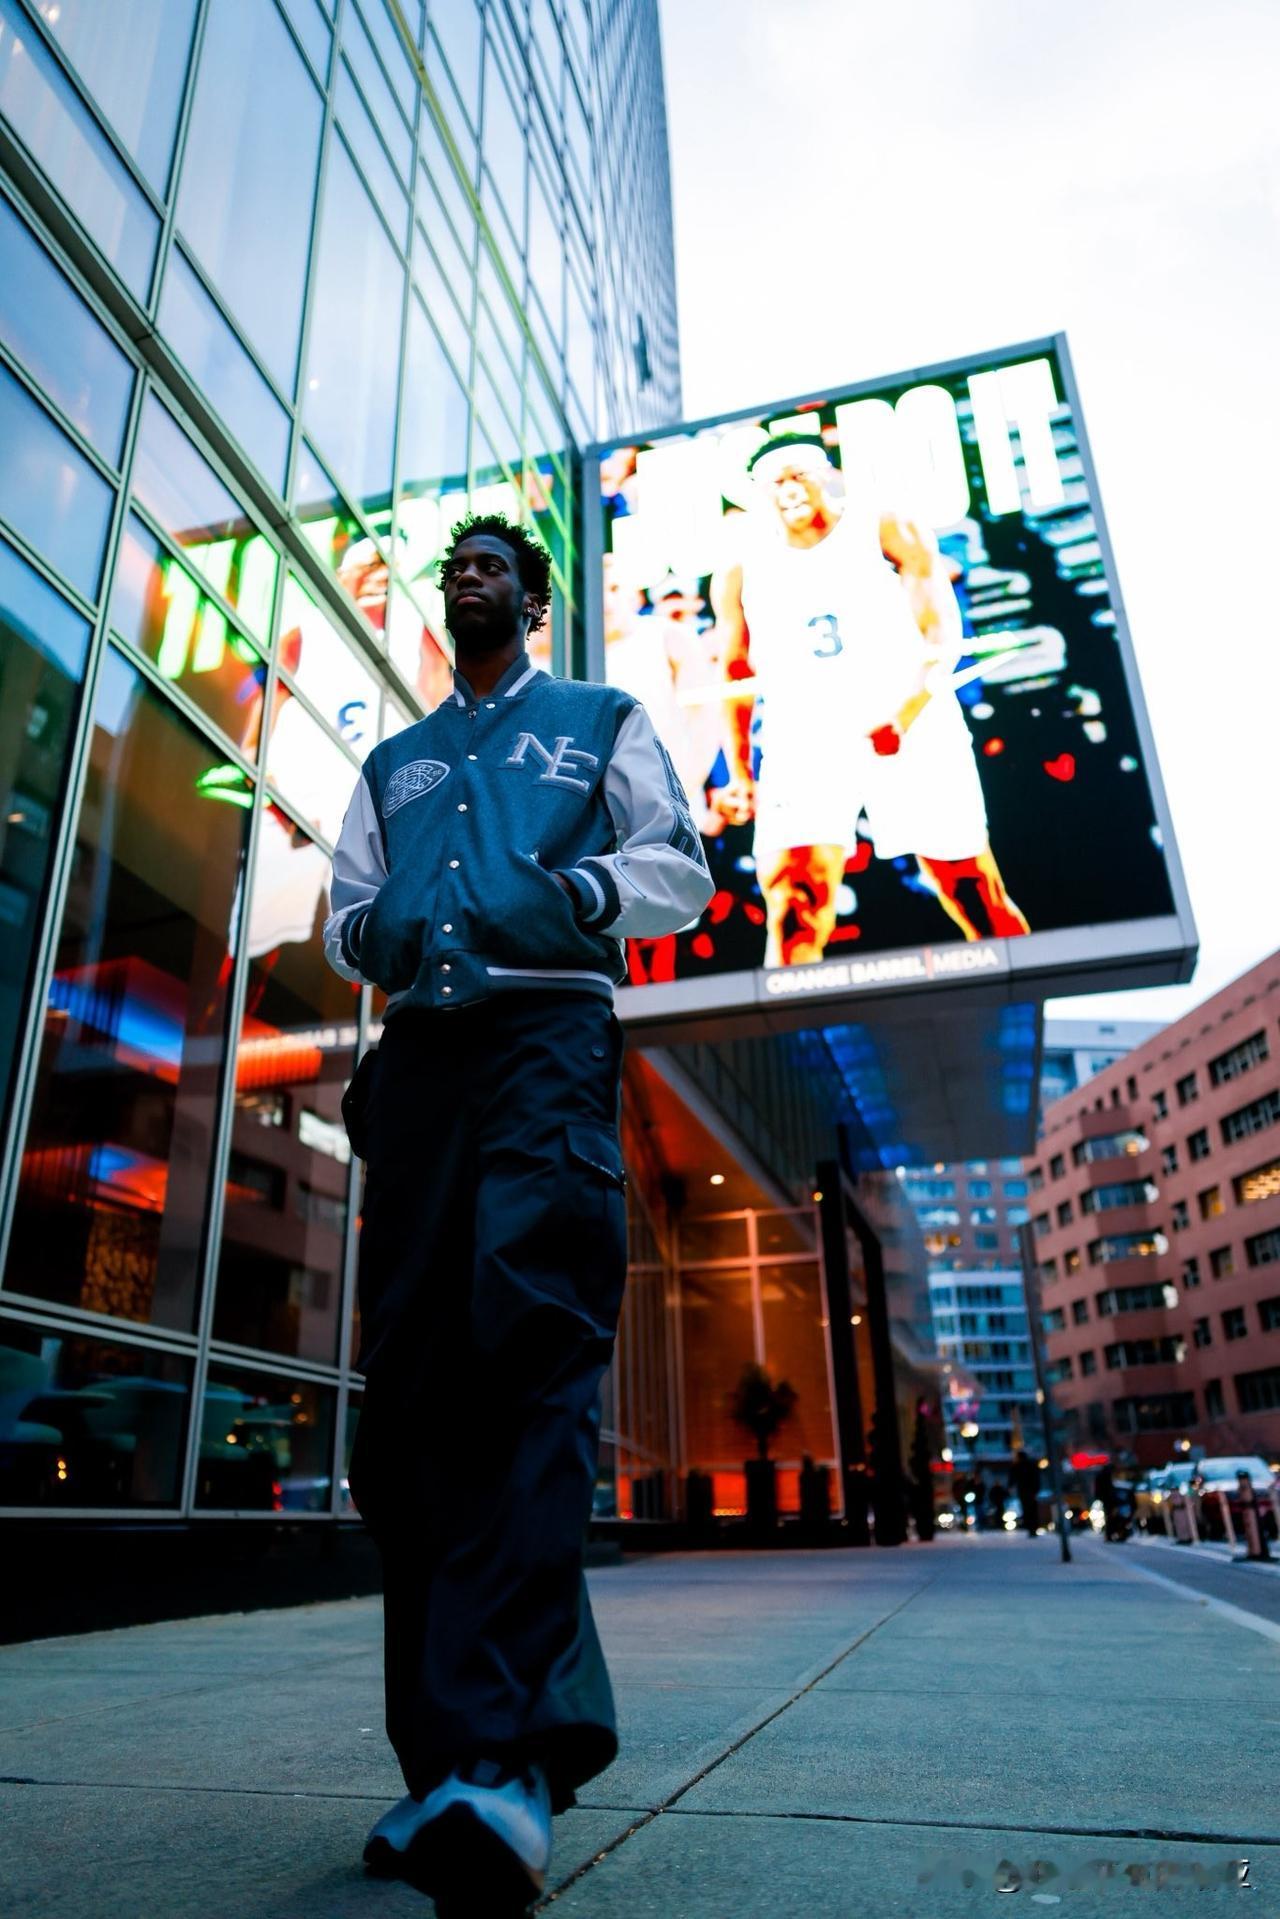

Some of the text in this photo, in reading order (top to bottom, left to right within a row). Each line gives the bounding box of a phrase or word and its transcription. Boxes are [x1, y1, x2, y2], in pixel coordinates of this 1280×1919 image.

[967, 358, 1065, 515] IT
[806, 615, 843, 658] 3
[503, 731, 600, 793] NE
[766, 947, 999, 994] ORANGE BARREL MEDIA
